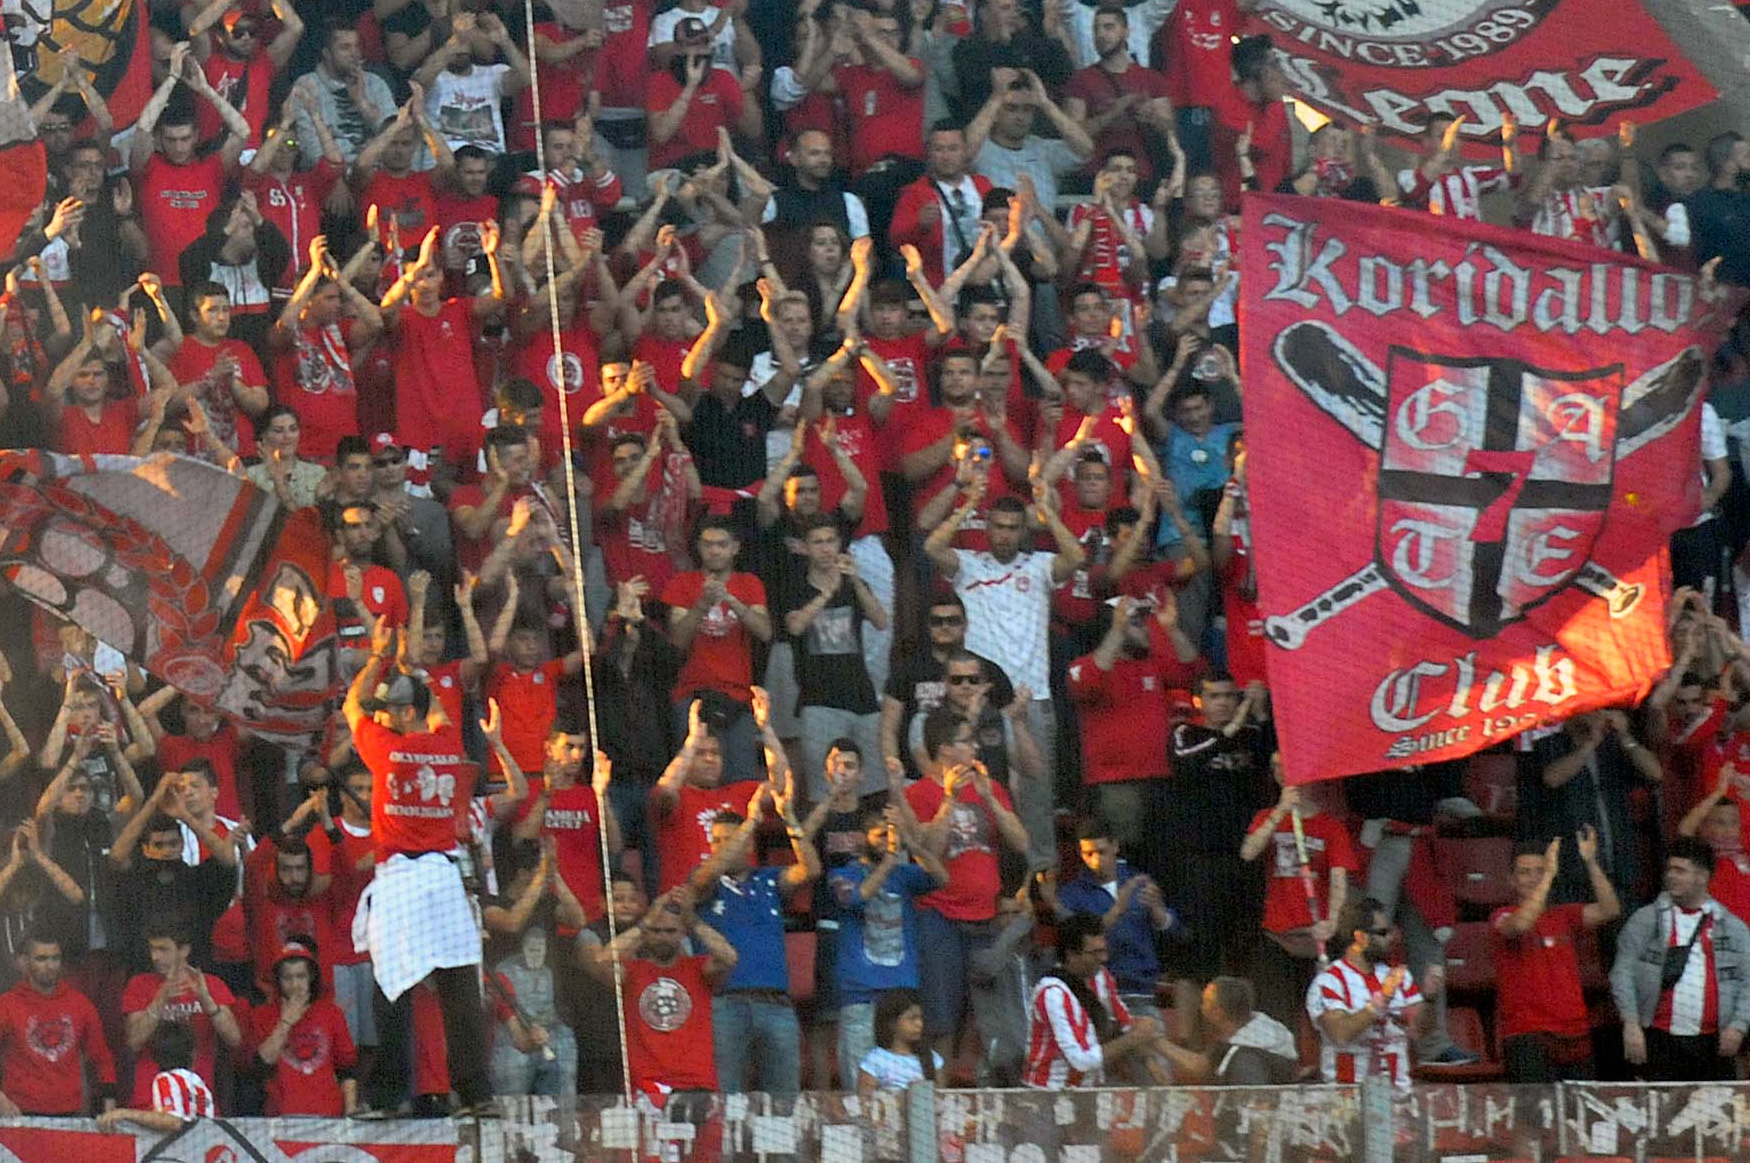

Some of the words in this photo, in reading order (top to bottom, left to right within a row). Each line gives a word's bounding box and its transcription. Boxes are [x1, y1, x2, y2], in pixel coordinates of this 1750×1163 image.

[1262, 7, 1431, 67] SINCE
[1437, 7, 1536, 62] 1989
[1369, 643, 1579, 734] Club
